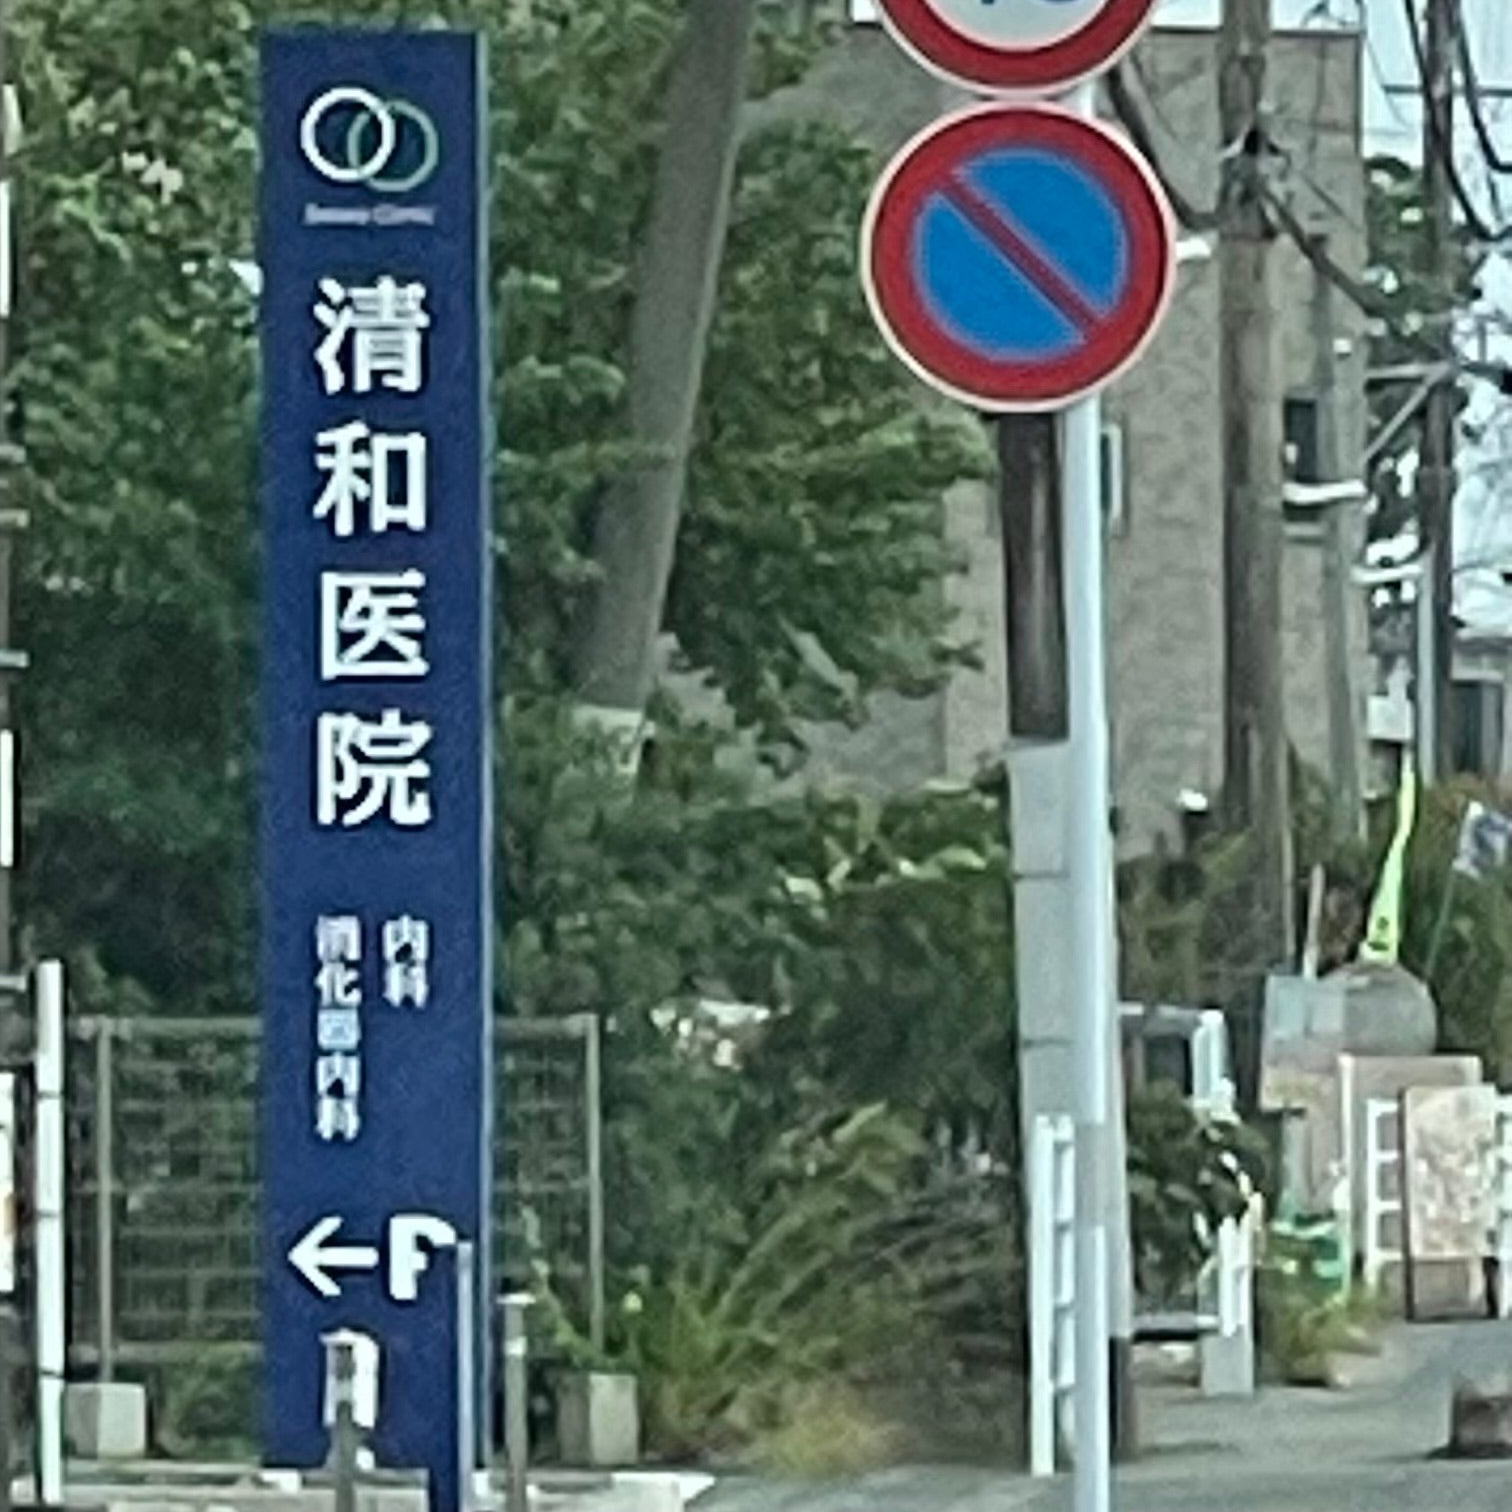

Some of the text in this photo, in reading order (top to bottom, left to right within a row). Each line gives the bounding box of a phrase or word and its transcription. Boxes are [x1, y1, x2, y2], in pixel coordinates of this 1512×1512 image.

[313, 275, 432, 828] 清和医院
[382, 914, 429, 1009] 内科
